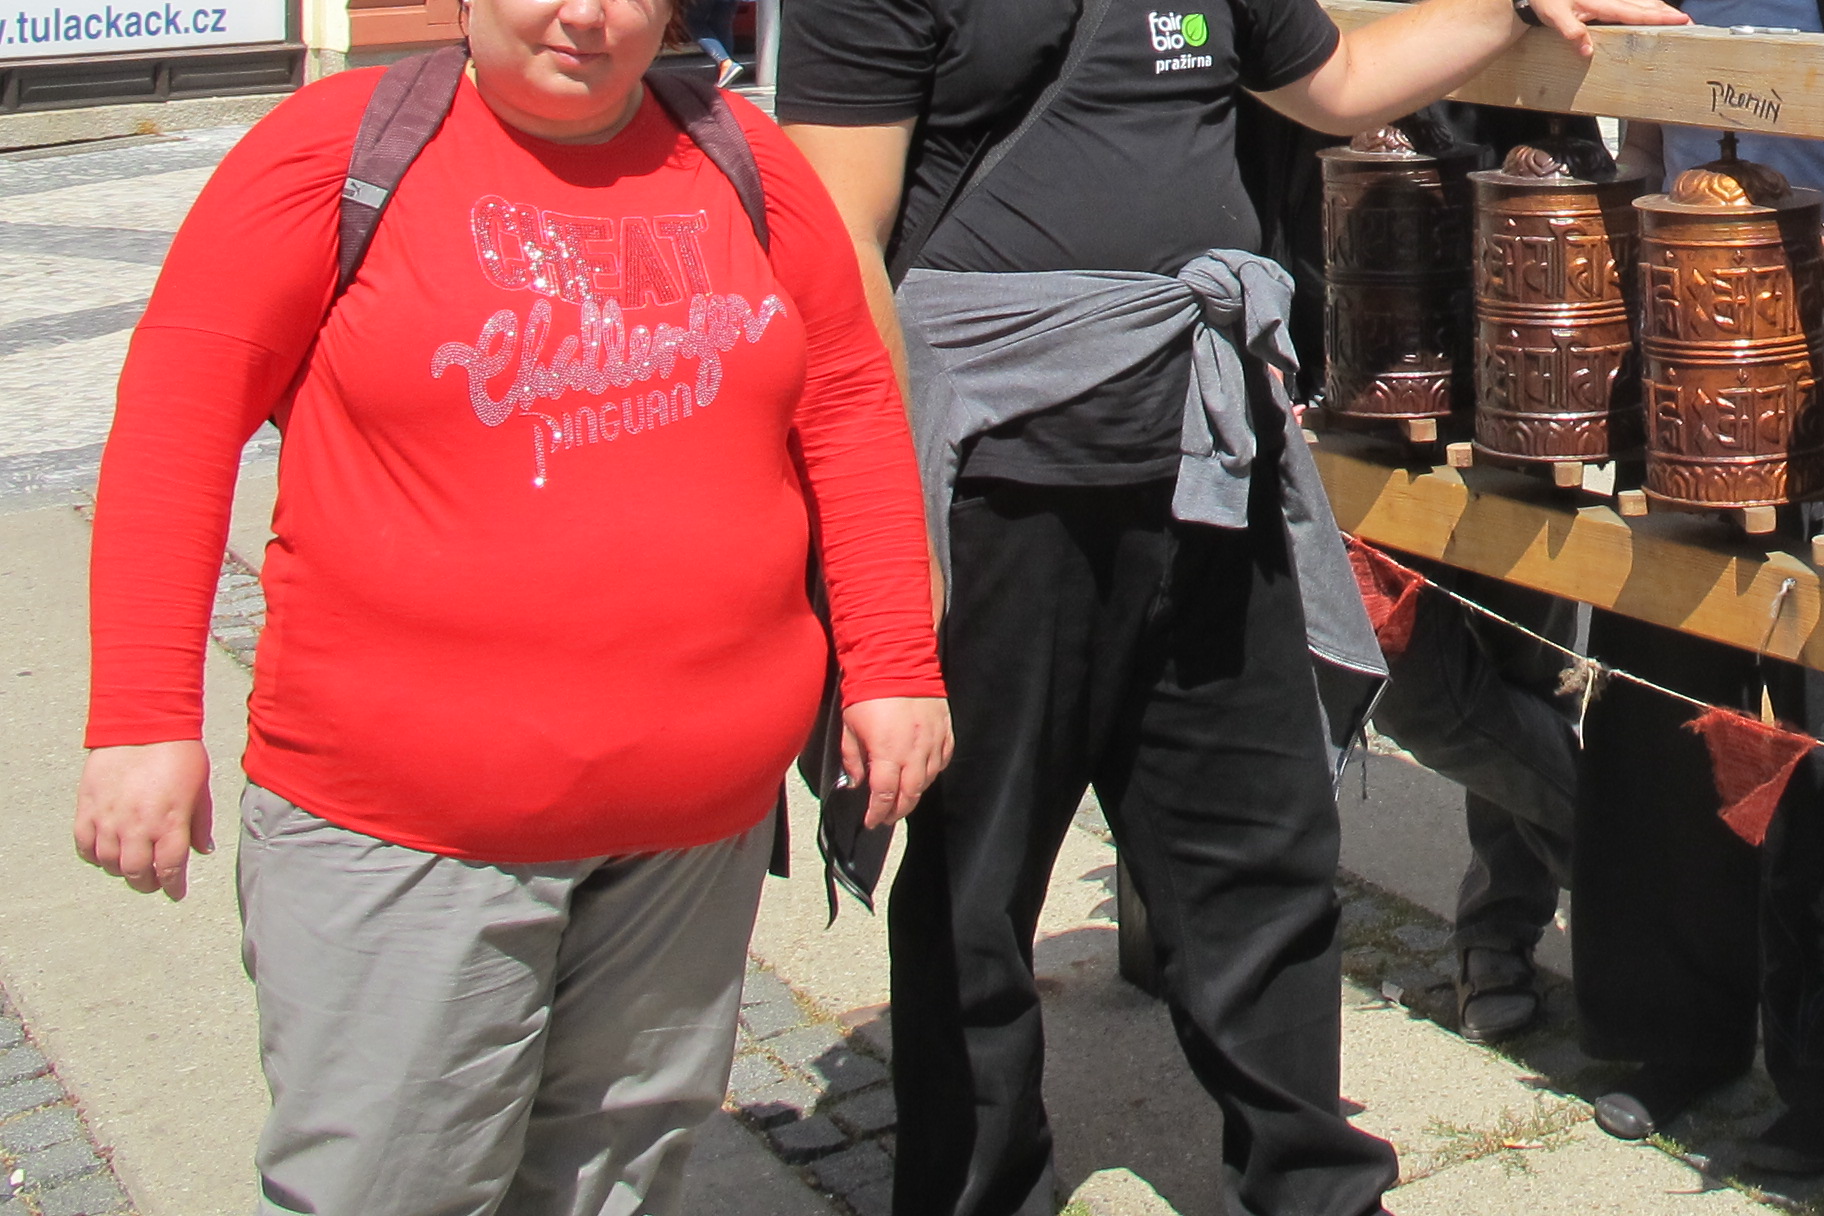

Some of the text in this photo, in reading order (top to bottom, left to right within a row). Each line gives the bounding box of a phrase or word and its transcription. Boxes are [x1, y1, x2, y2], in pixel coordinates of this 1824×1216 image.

[1148, 11, 1183, 32] fair
[1152, 30, 1185, 52] bio
[470, 193, 713, 311] CHEAT
